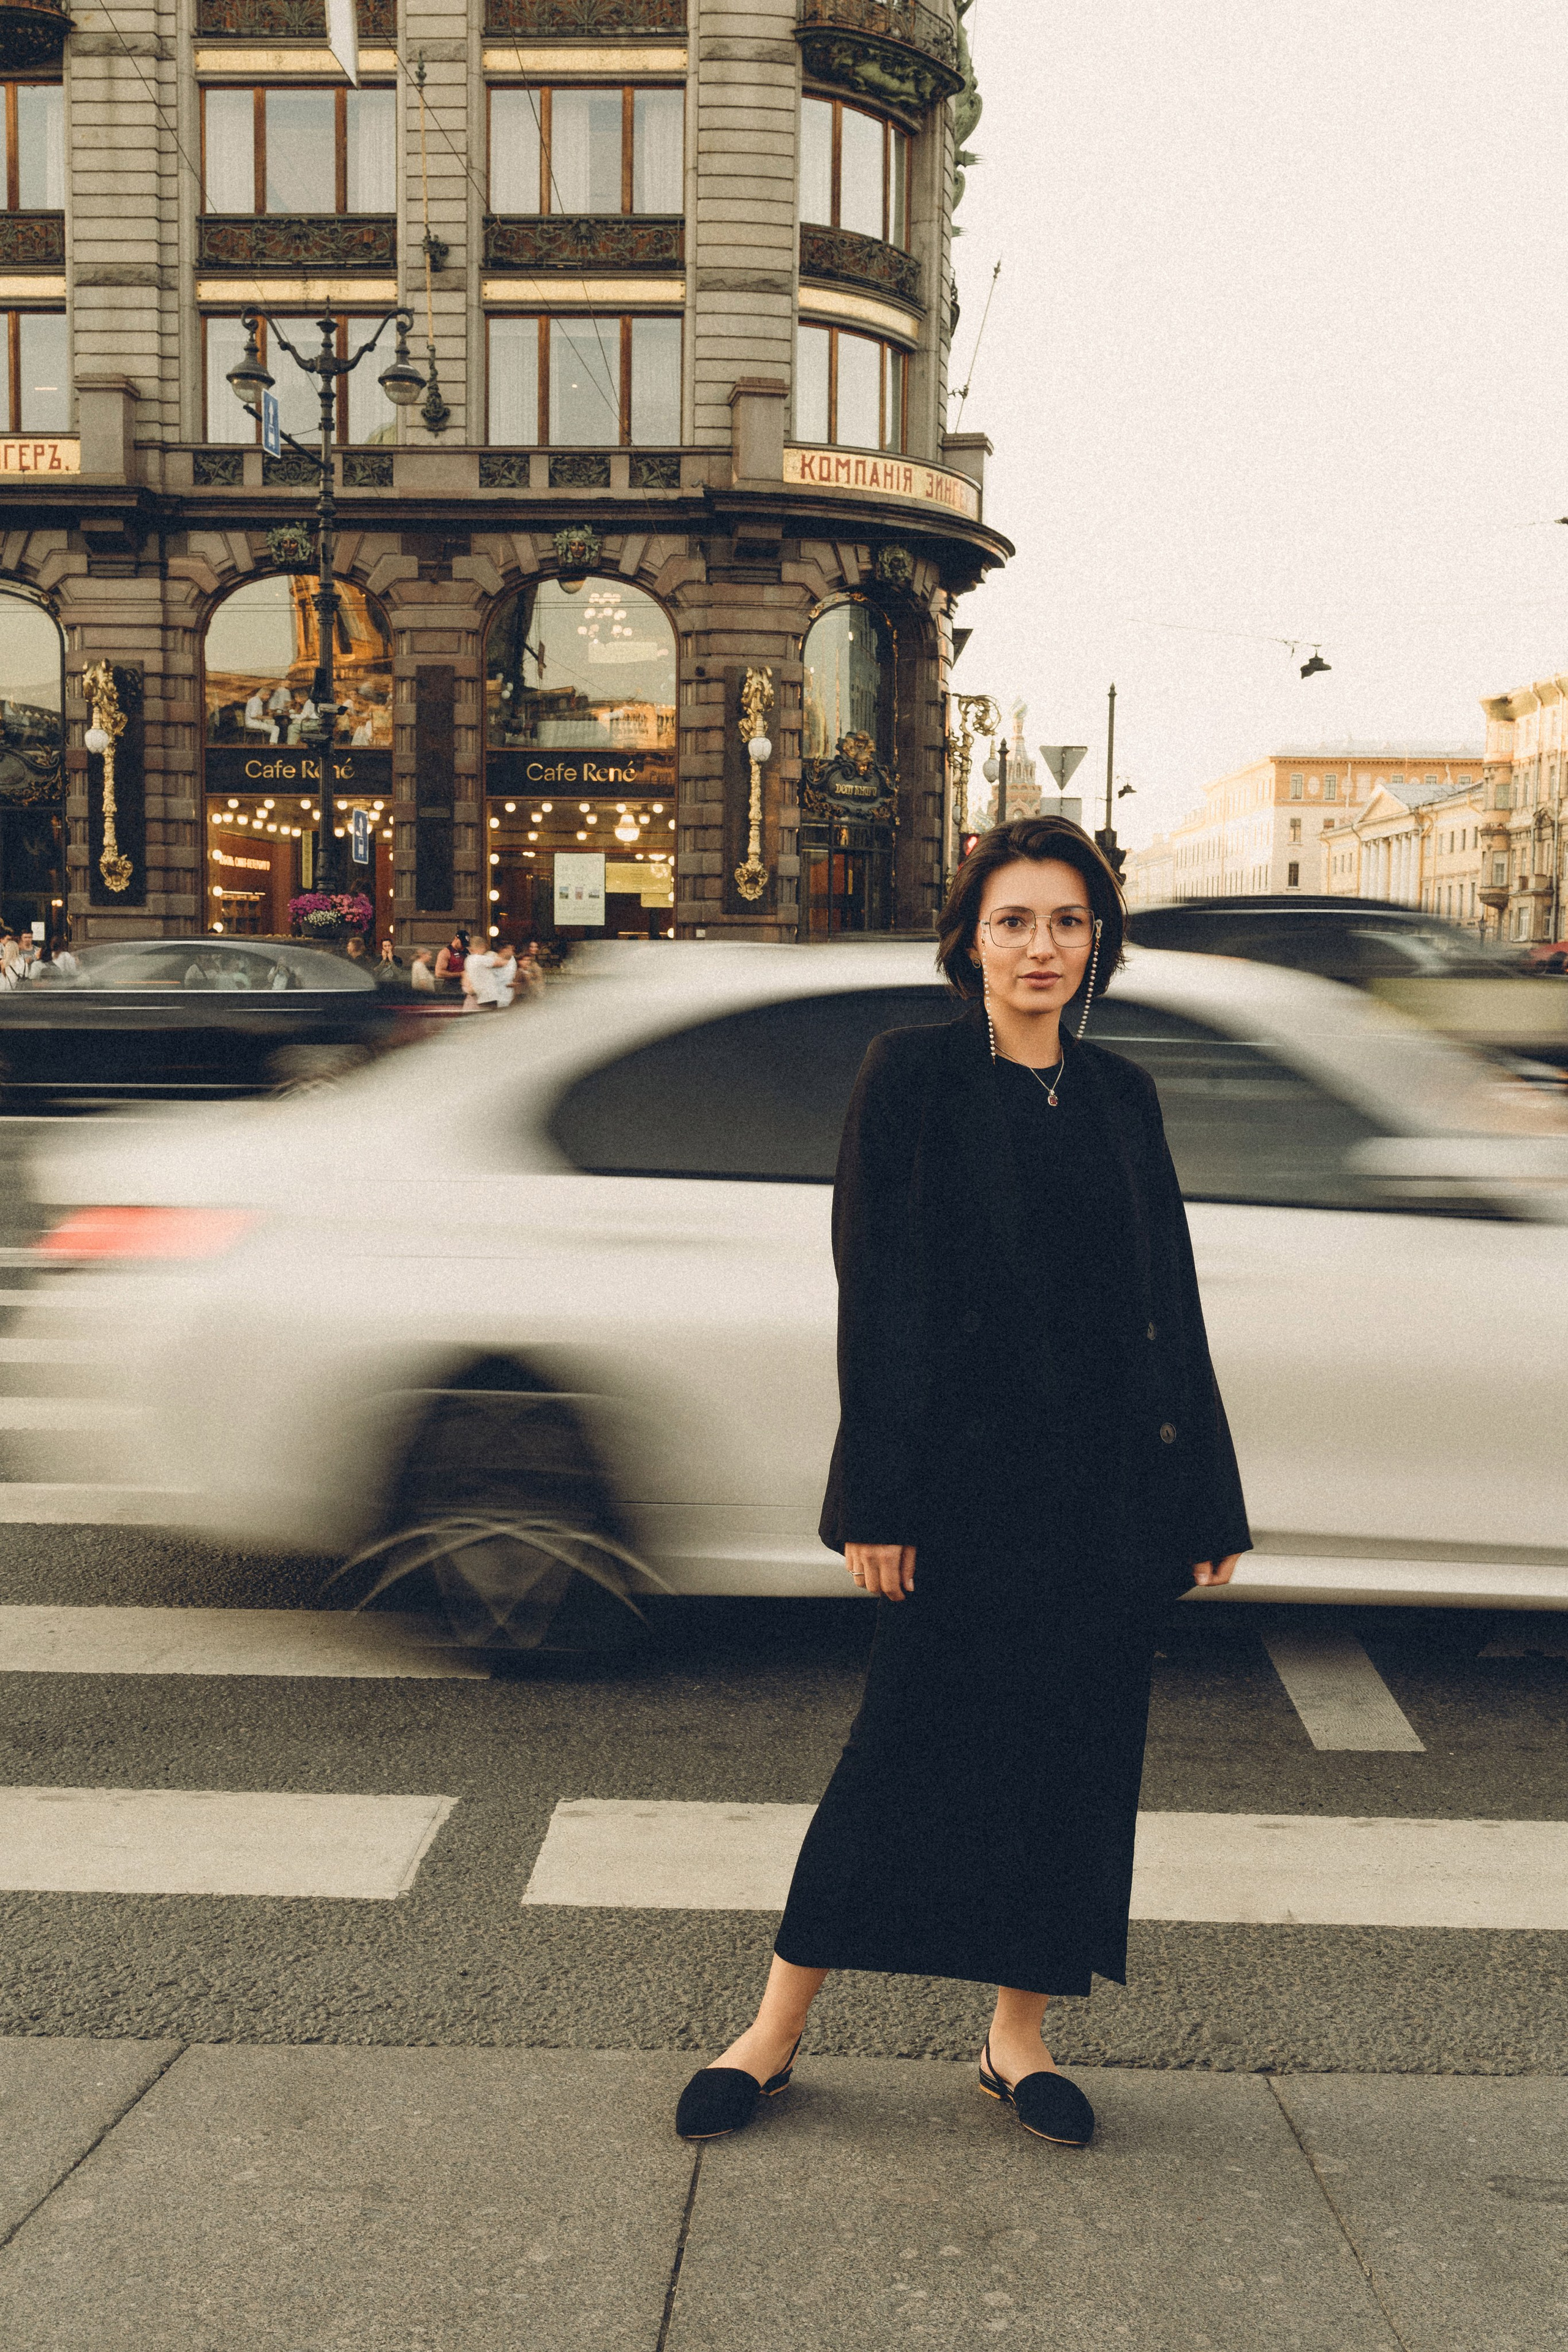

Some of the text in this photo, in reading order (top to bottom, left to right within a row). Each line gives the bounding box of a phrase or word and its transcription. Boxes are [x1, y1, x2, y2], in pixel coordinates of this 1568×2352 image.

[801, 454, 913, 493] КОМПАНІЯ
[246, 760, 296, 779] Cafe
[527, 761, 639, 782] Cafe René
